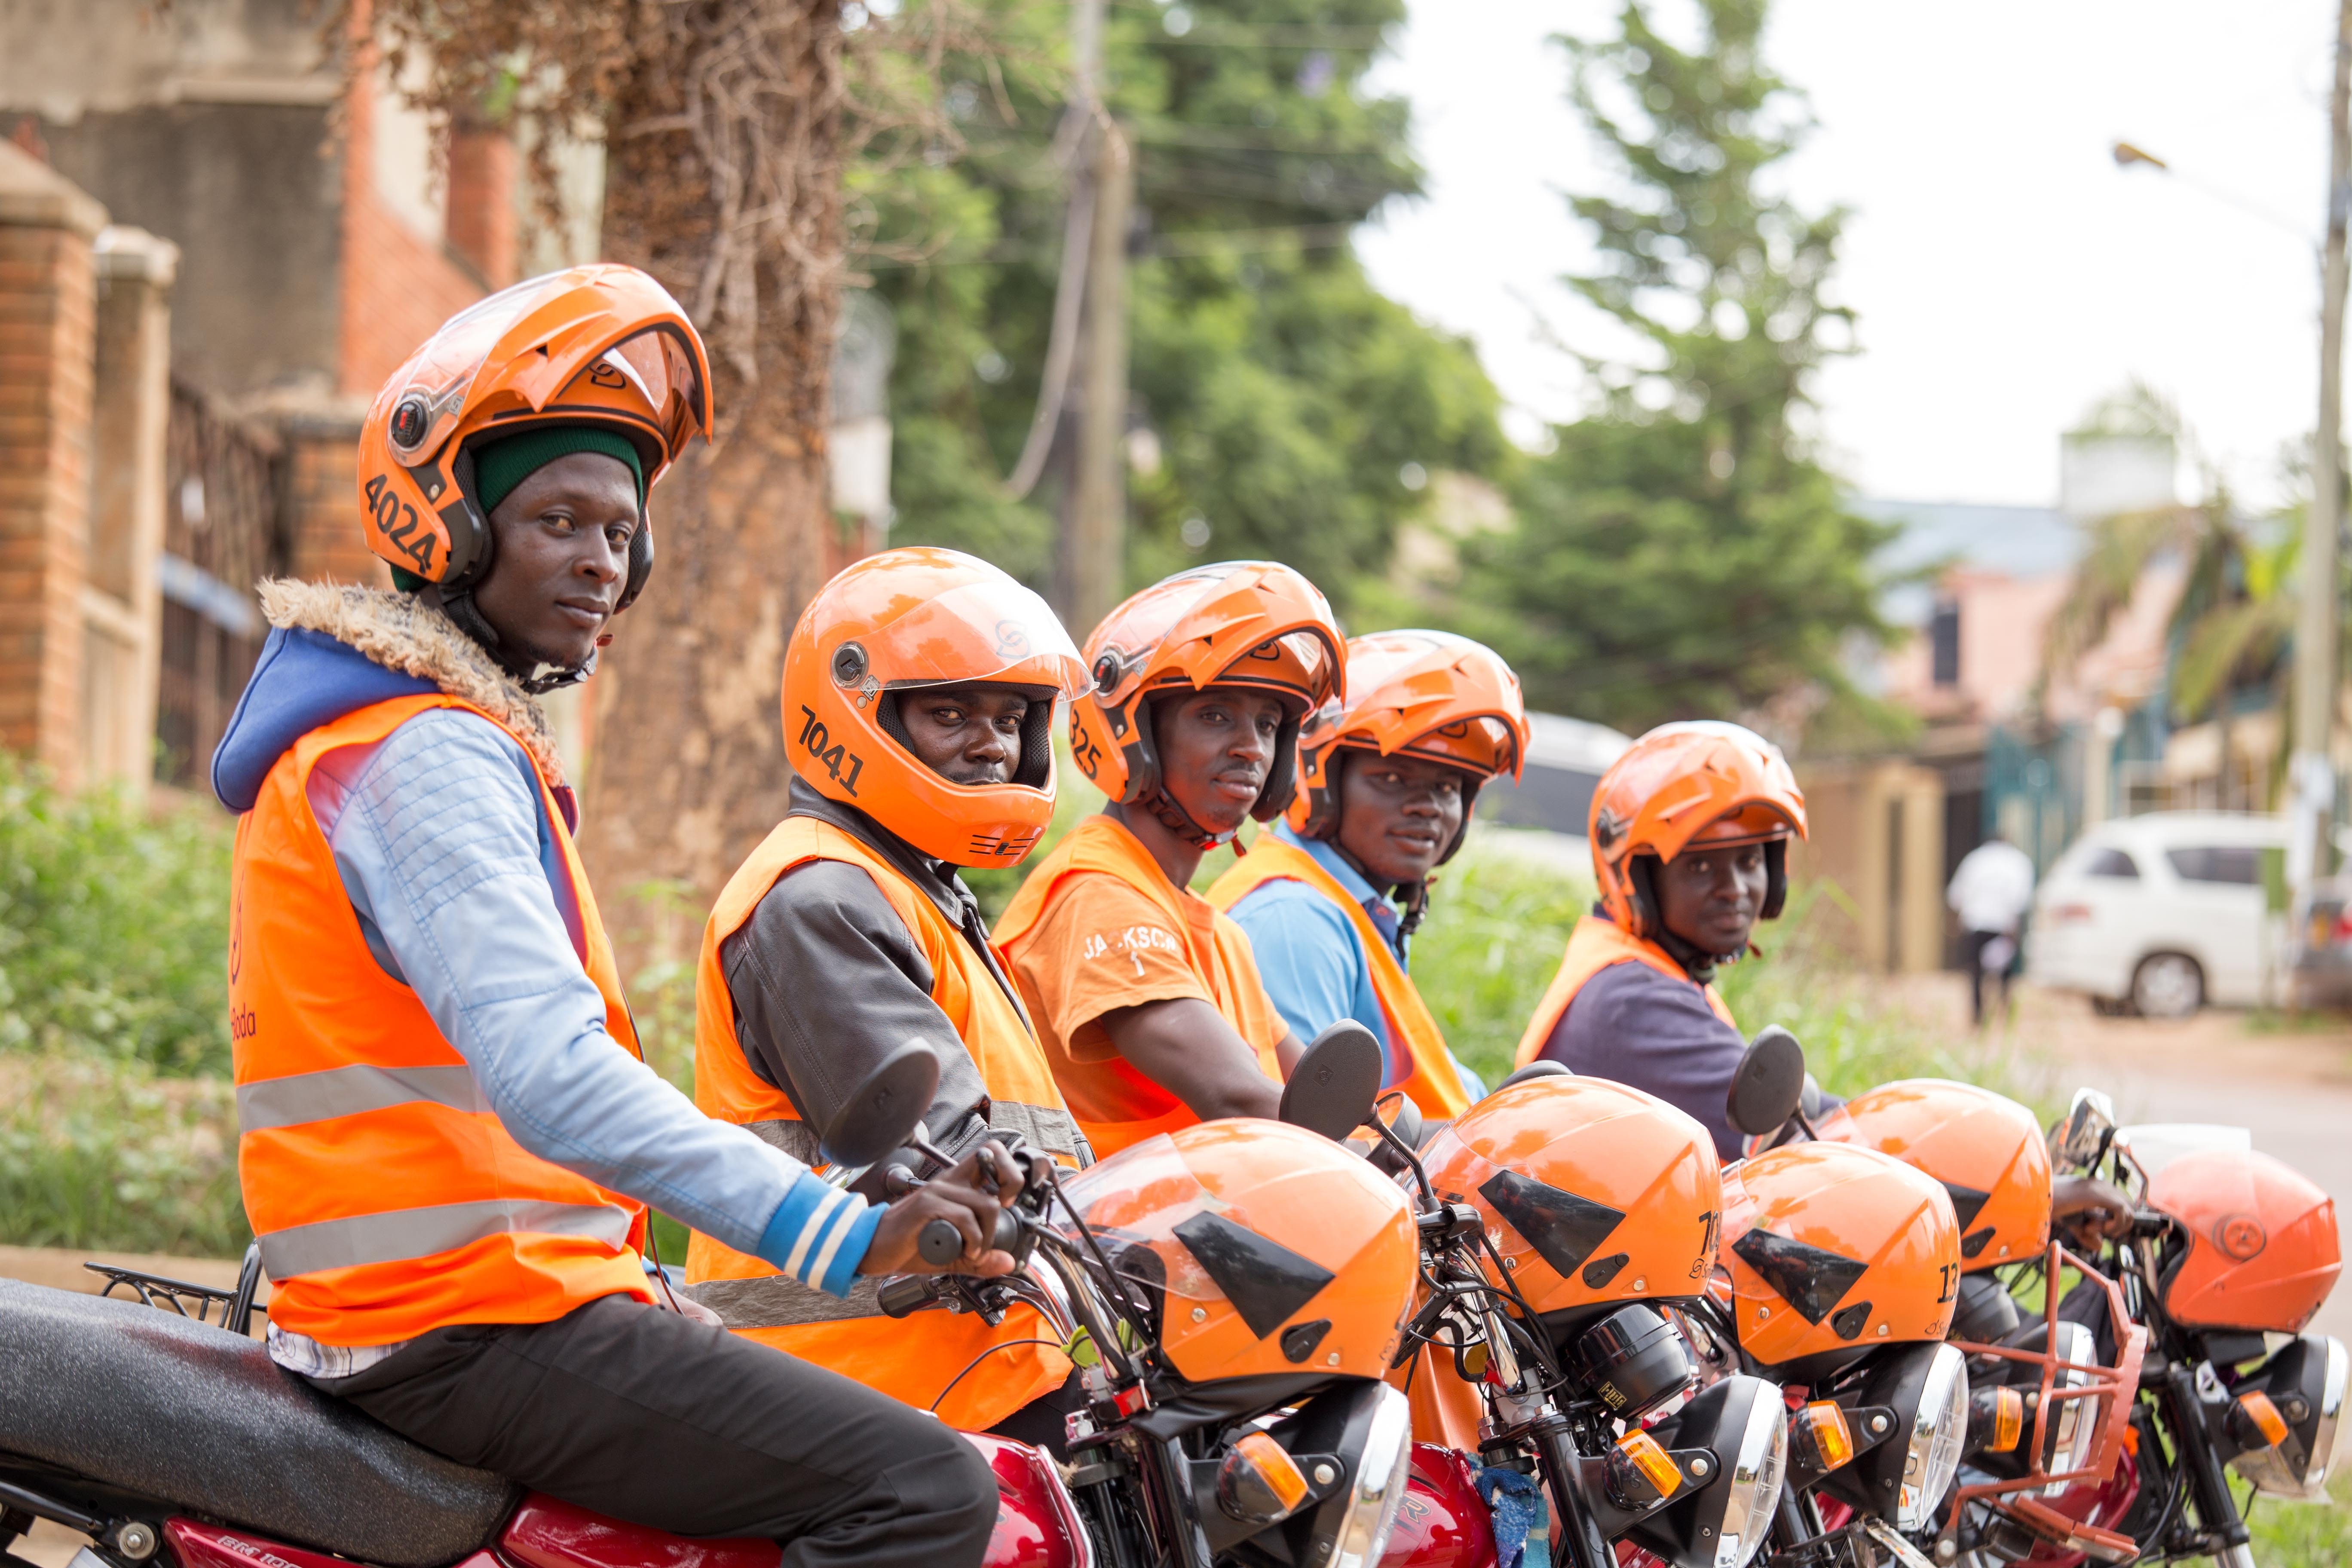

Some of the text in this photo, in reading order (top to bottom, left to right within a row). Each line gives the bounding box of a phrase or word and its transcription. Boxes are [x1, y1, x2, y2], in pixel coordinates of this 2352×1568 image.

[365, 474, 437, 575] 4024
[1084, 926, 1176, 960] JAKSON
[1699, 1210, 1722, 1256] 70
